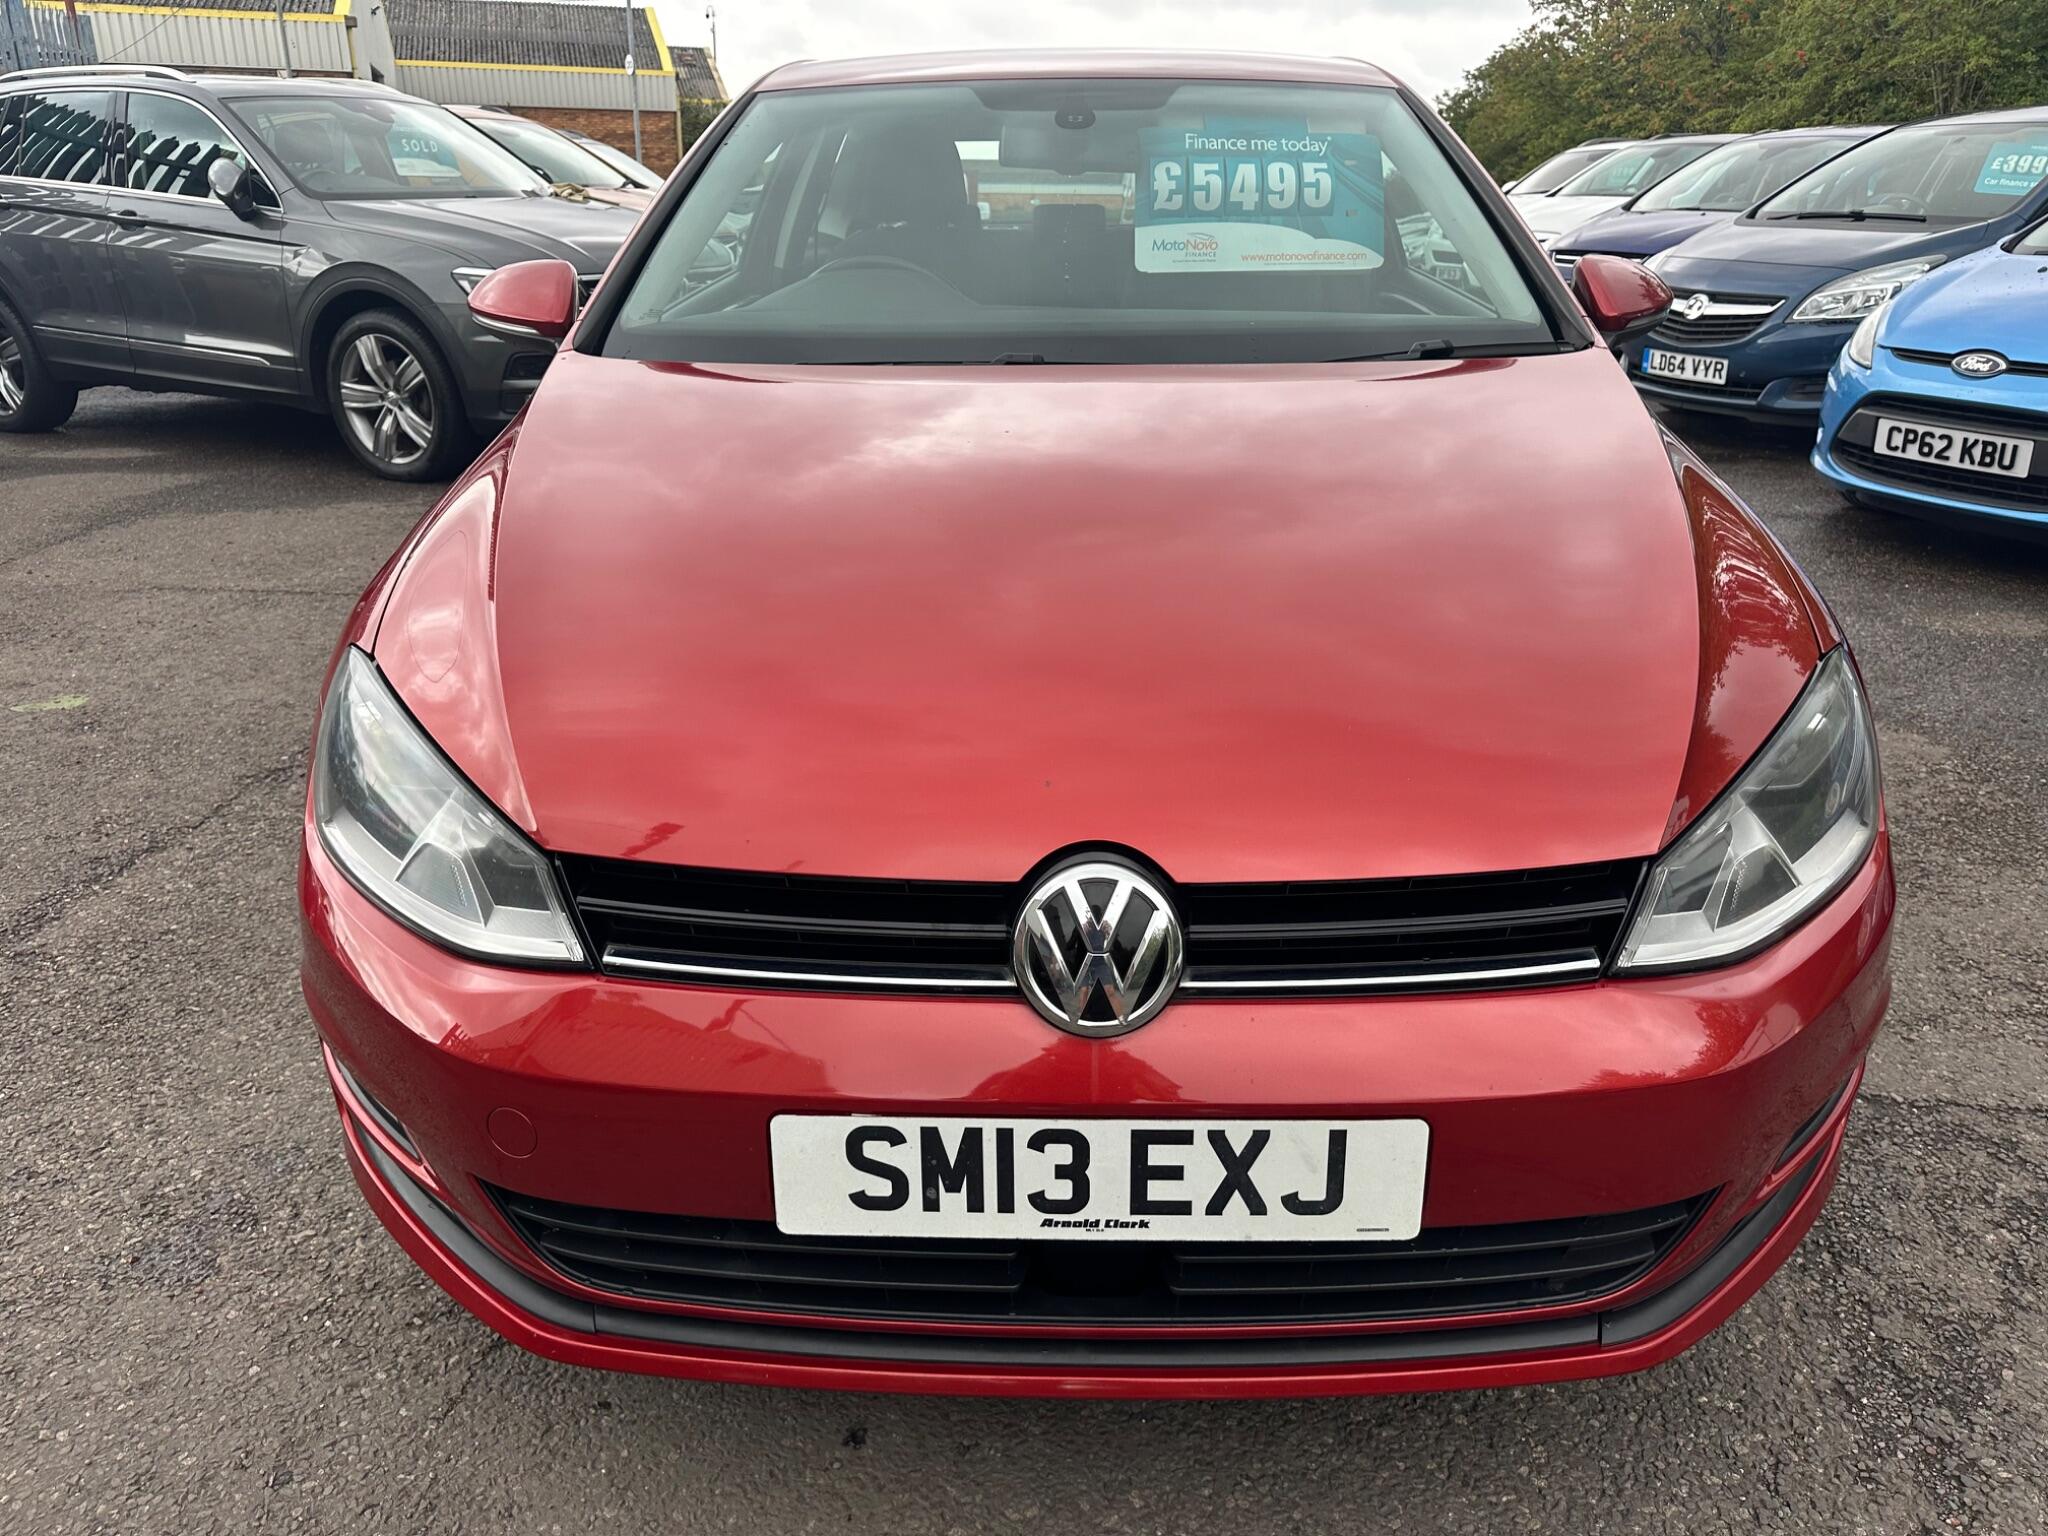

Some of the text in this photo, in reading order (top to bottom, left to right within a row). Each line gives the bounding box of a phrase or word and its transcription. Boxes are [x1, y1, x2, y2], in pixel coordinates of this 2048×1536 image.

[401, 139, 438, 152] SOLD
[1185, 133, 1247, 151] Finance
[1251, 137, 1277, 151] me
[1153, 161, 1332, 212] £5495
[1984, 177, 1998, 185] Car
[1152, 239, 1218, 251] MotoNovo
[1241, 250, 1367, 262] www.motonovofinance.com
[1650, 352, 1725, 380] LD64 VYR
[1960, 356, 1993, 371] Ford
[1886, 426, 2019, 471] CP62 KBU
[845, 1125, 1348, 1216] SM13 EXJ
[1040, 1218, 1150, 1229] Arnold Clark
